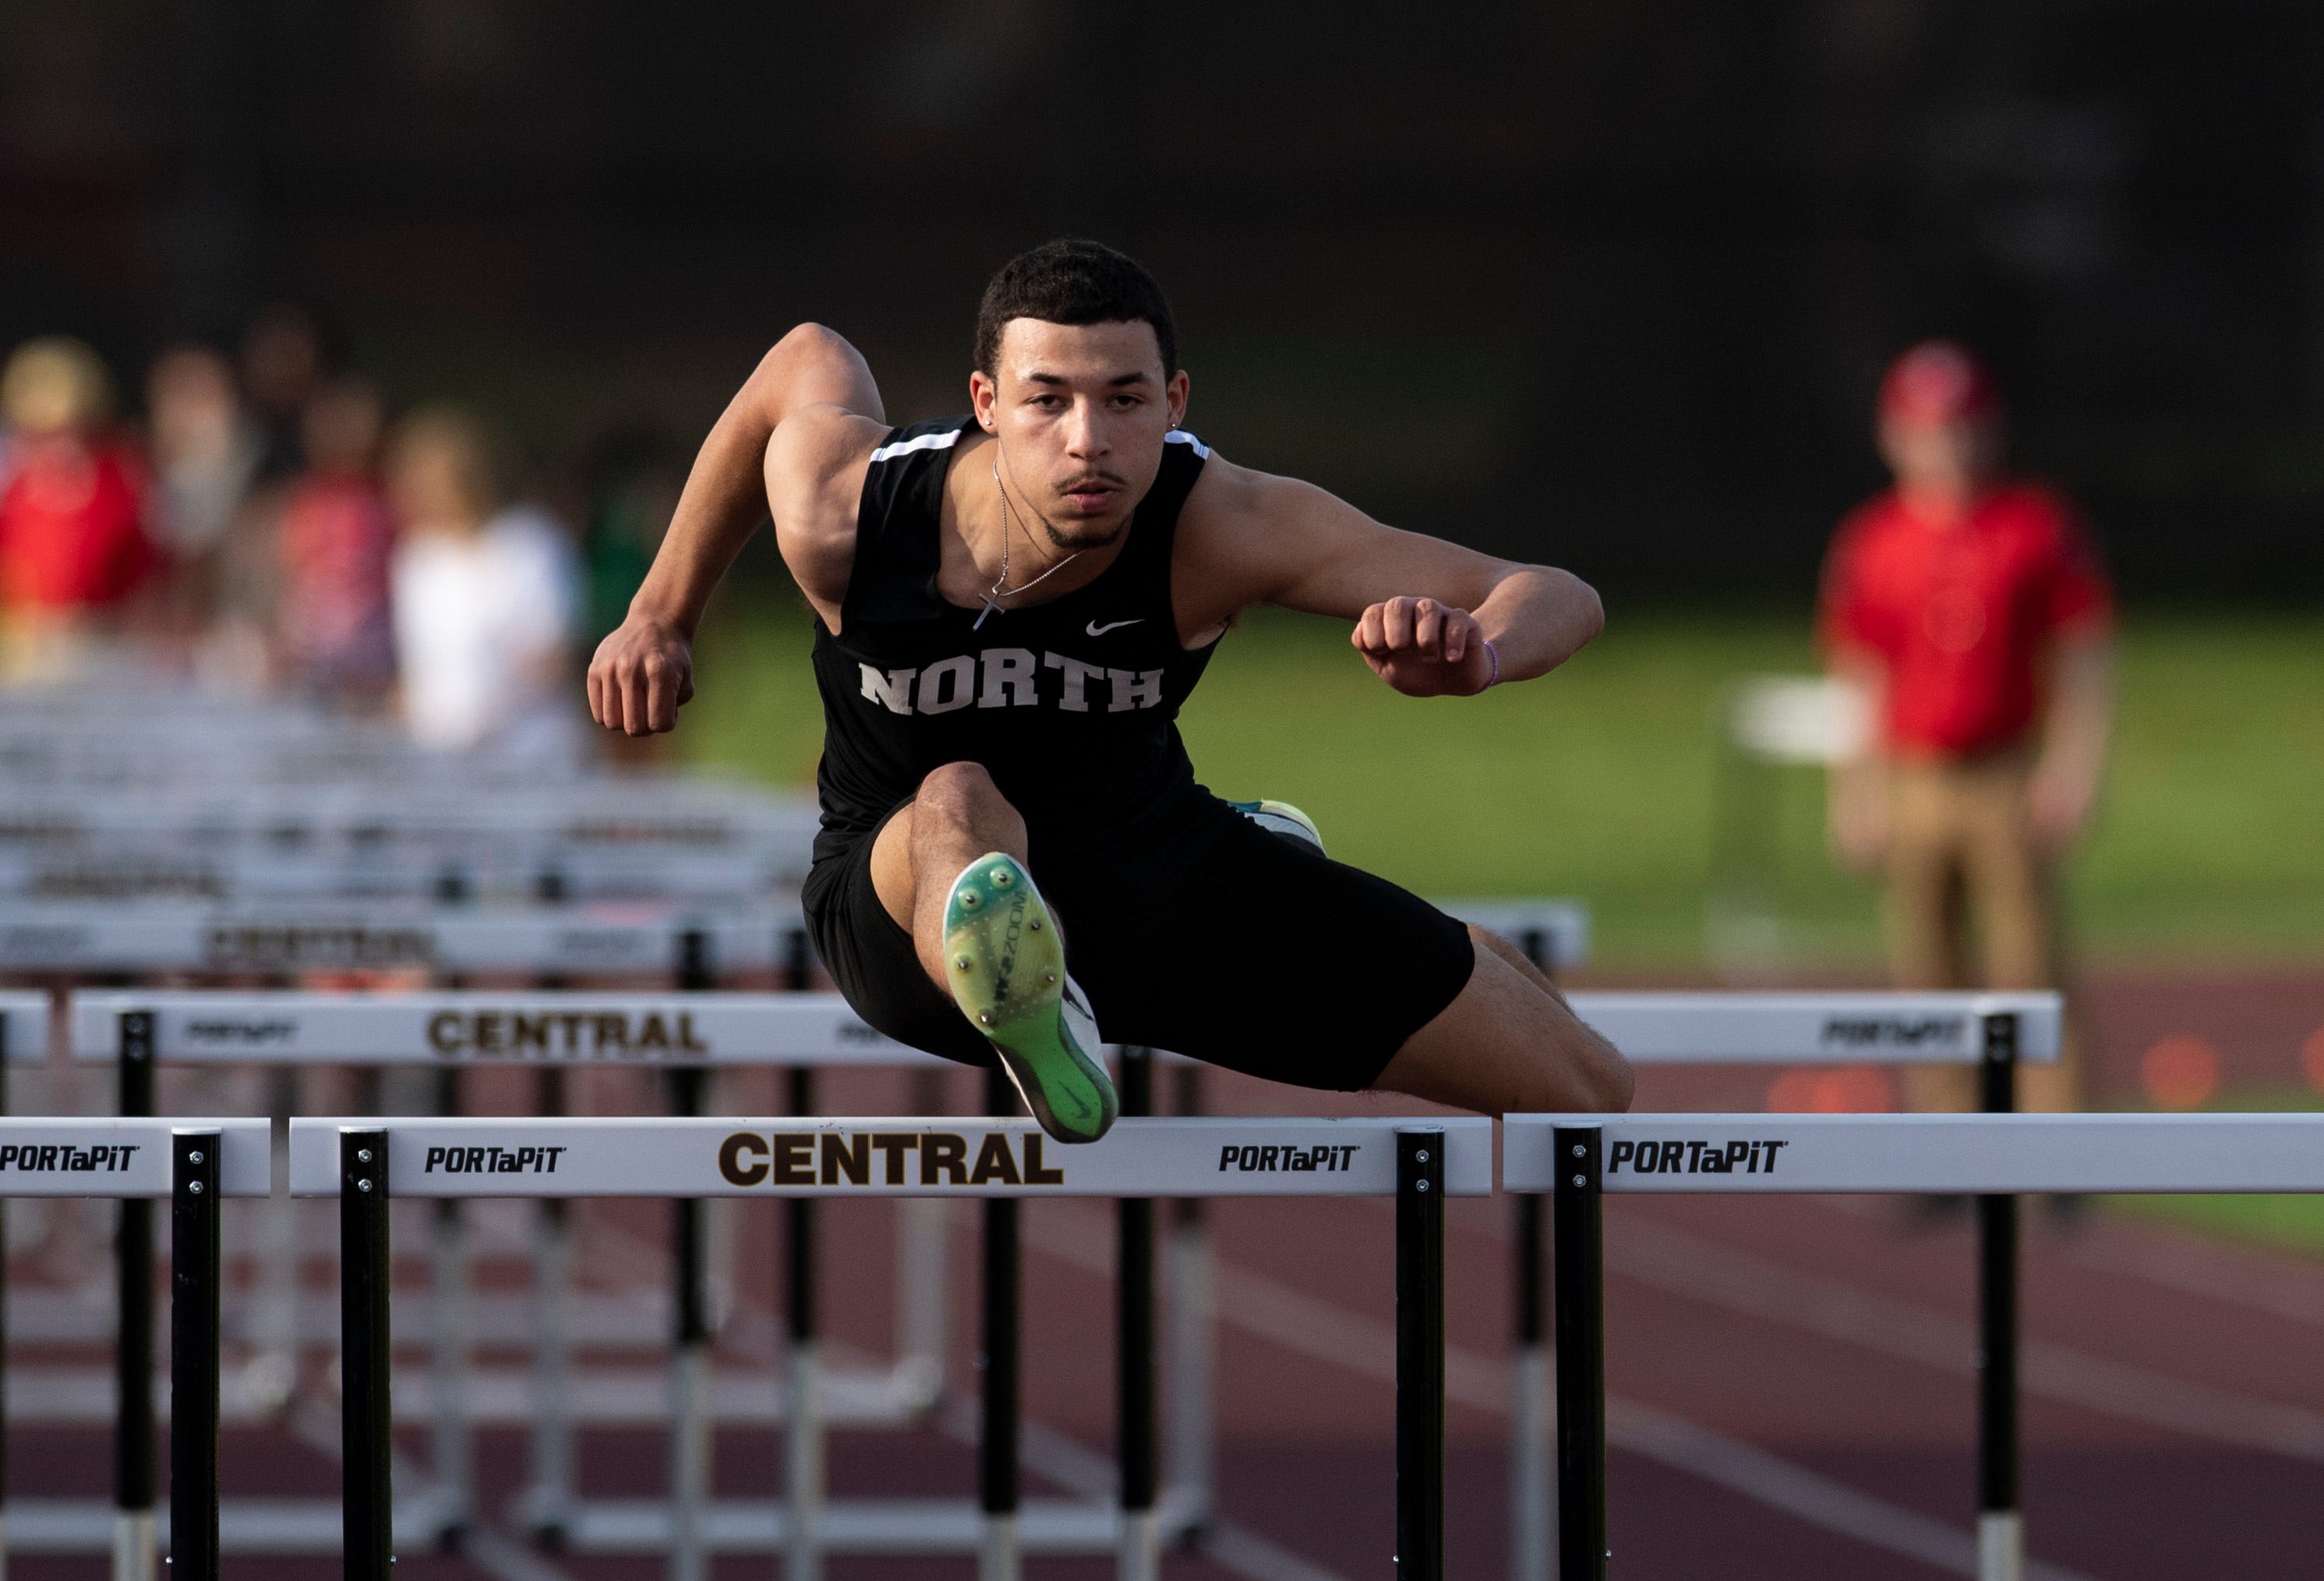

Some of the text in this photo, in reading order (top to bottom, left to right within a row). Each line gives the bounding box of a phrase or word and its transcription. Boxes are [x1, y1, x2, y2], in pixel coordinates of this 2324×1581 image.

[858, 648, 1164, 715] NORTH
[1003, 891, 1027, 955] ZOOM
[428, 1011, 709, 1053] CENTRAL
[0, 1145, 136, 1171] PORTaPiT
[425, 1132, 1357, 1187] PORTaPiT CENTRAL PORTaPiT
[1609, 1141, 1785, 1173] PORTaPiT
